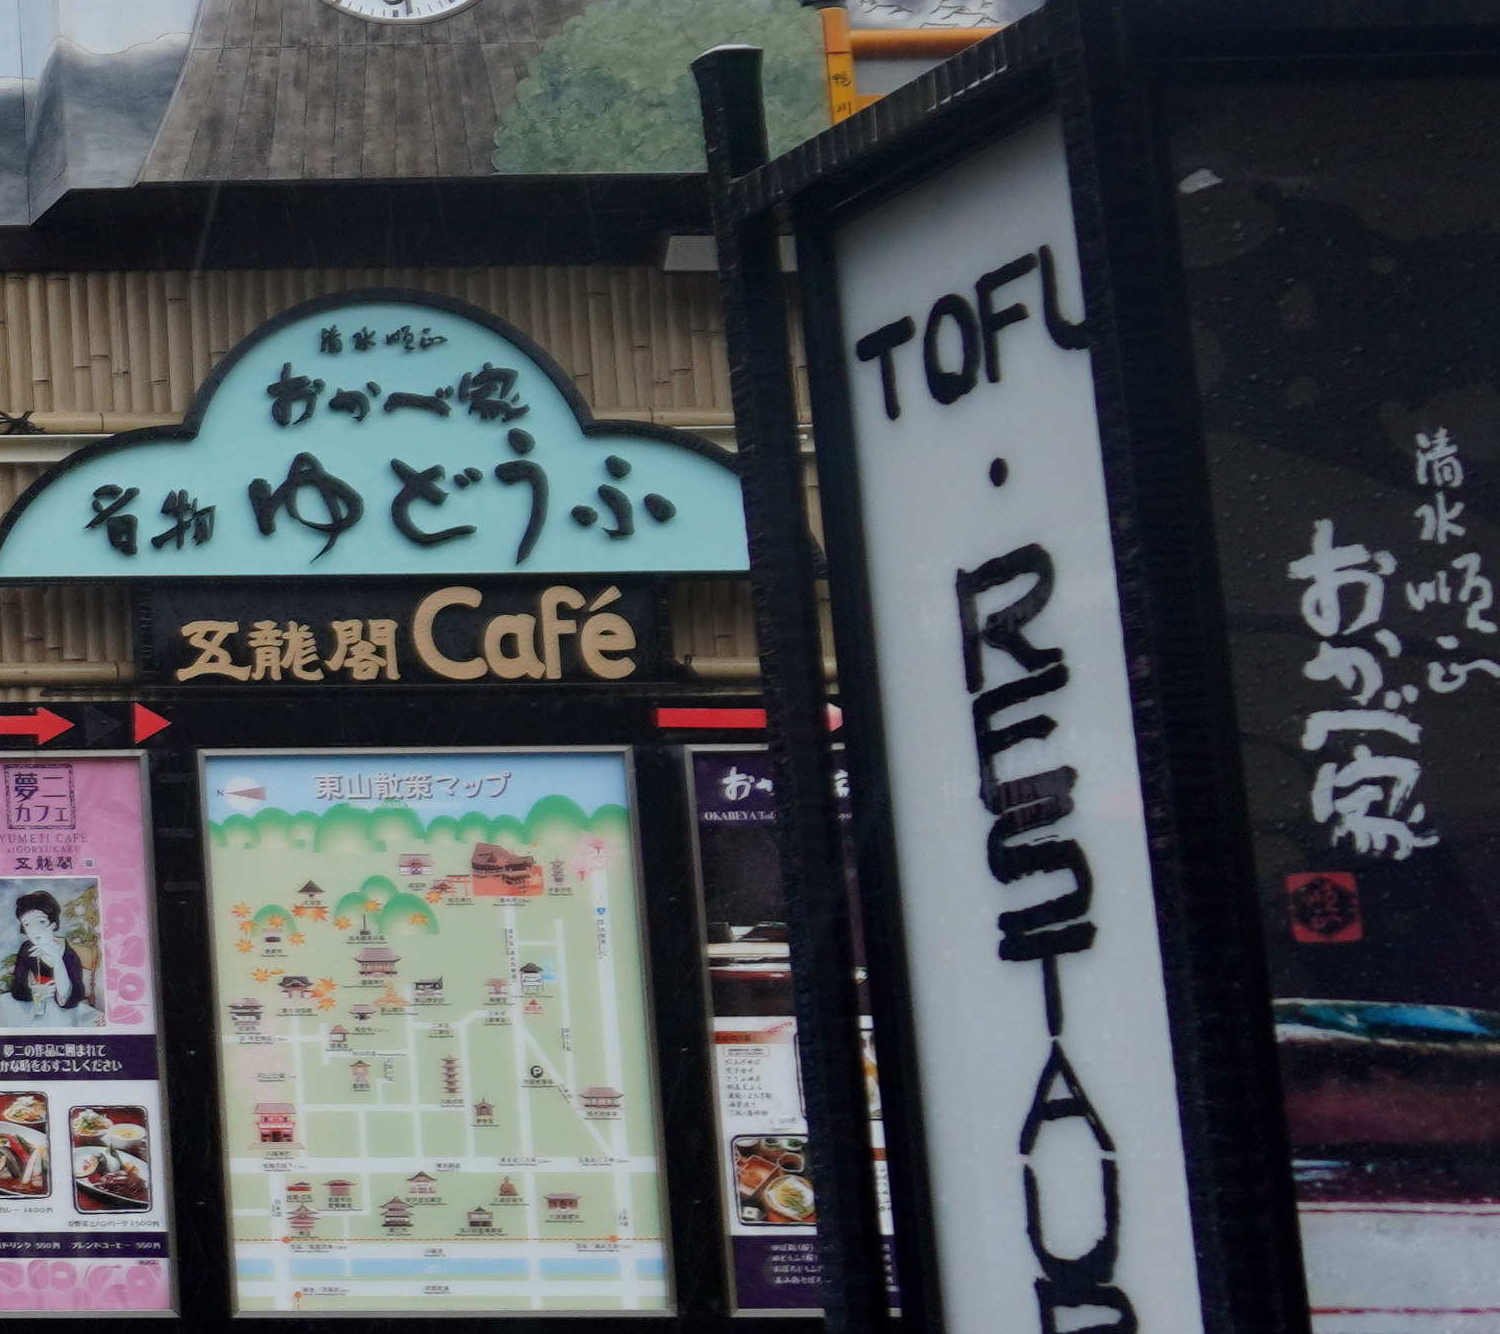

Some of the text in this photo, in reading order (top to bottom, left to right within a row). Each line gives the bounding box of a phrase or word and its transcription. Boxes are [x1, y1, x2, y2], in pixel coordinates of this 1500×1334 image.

[266, 360, 531, 426] おかべ家
[248, 427, 678, 566] ゆどうふ
[412, 585, 638, 681] Café
[1287, 517, 1441, 860] おかべ家
[13, 772, 67, 803] 夢二
[15, 803, 70, 822] カフェ
[313, 770, 513, 800] 東山散策マップ
